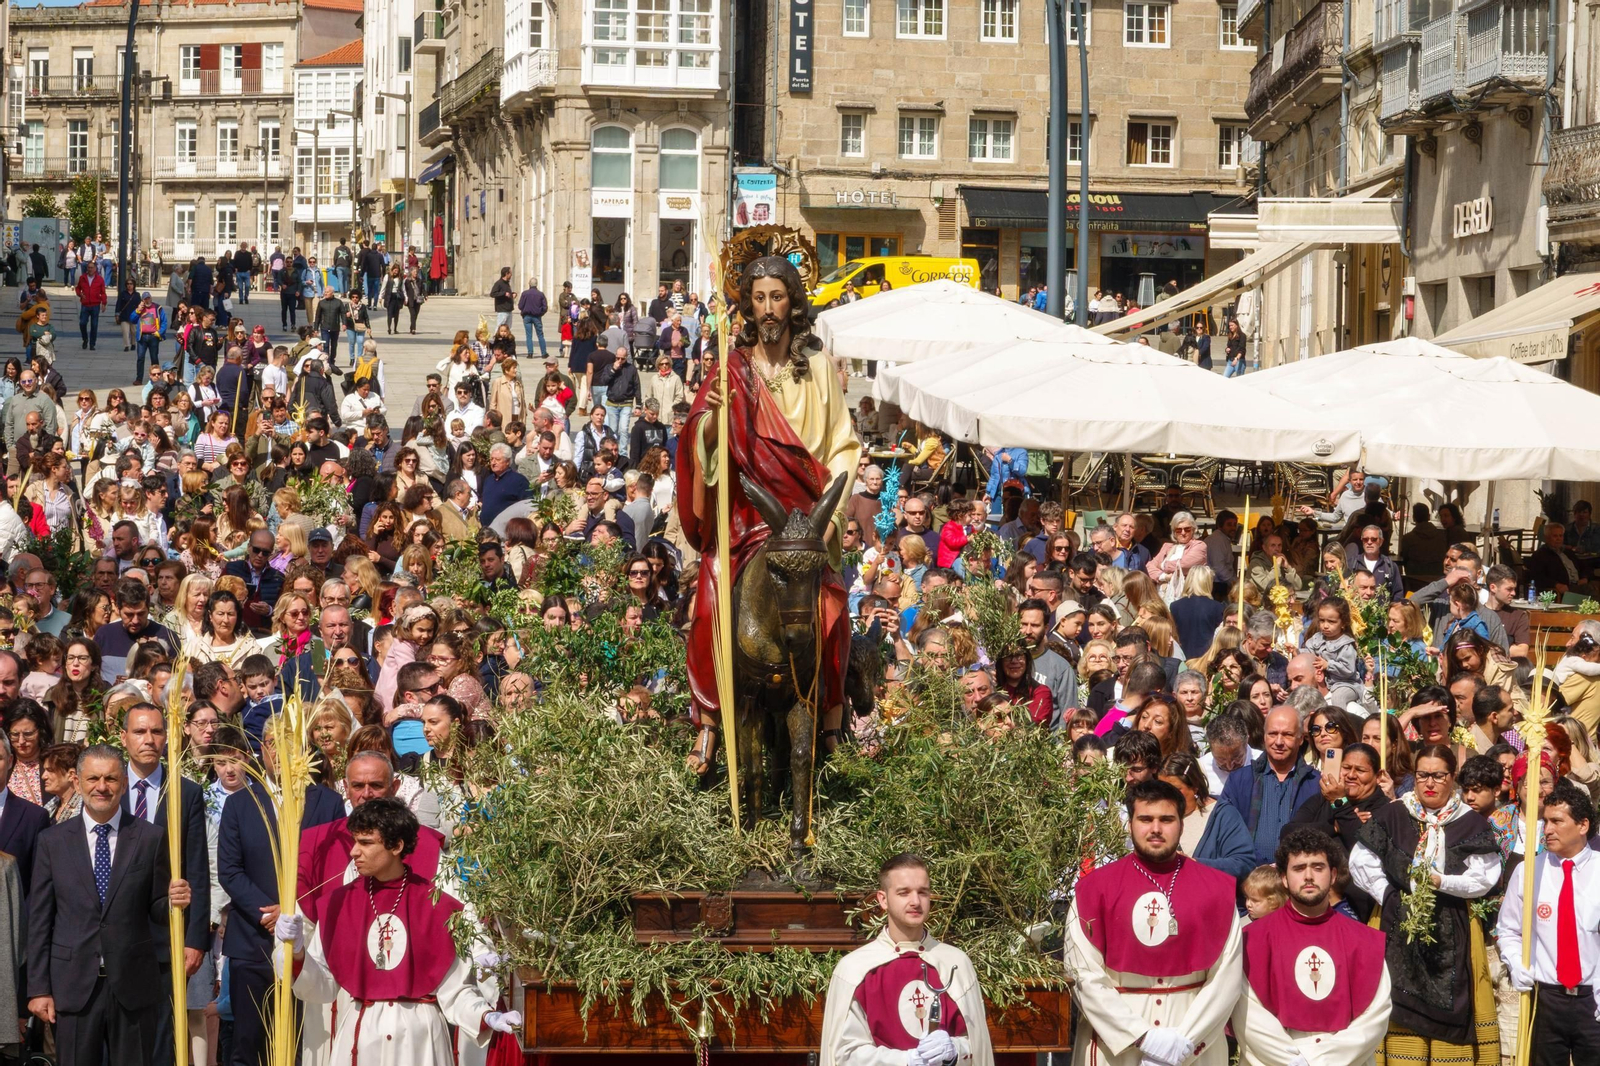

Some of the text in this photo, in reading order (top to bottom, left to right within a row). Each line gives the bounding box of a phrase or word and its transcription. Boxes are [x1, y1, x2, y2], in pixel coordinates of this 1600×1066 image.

[795, 0, 808, 74] TEL
[836, 190, 900, 205] HOTEL
[1076, 221, 1119, 231] Cntralita
[1510, 342, 1529, 360] Coffee
[1529, 340, 1540, 357] bar
